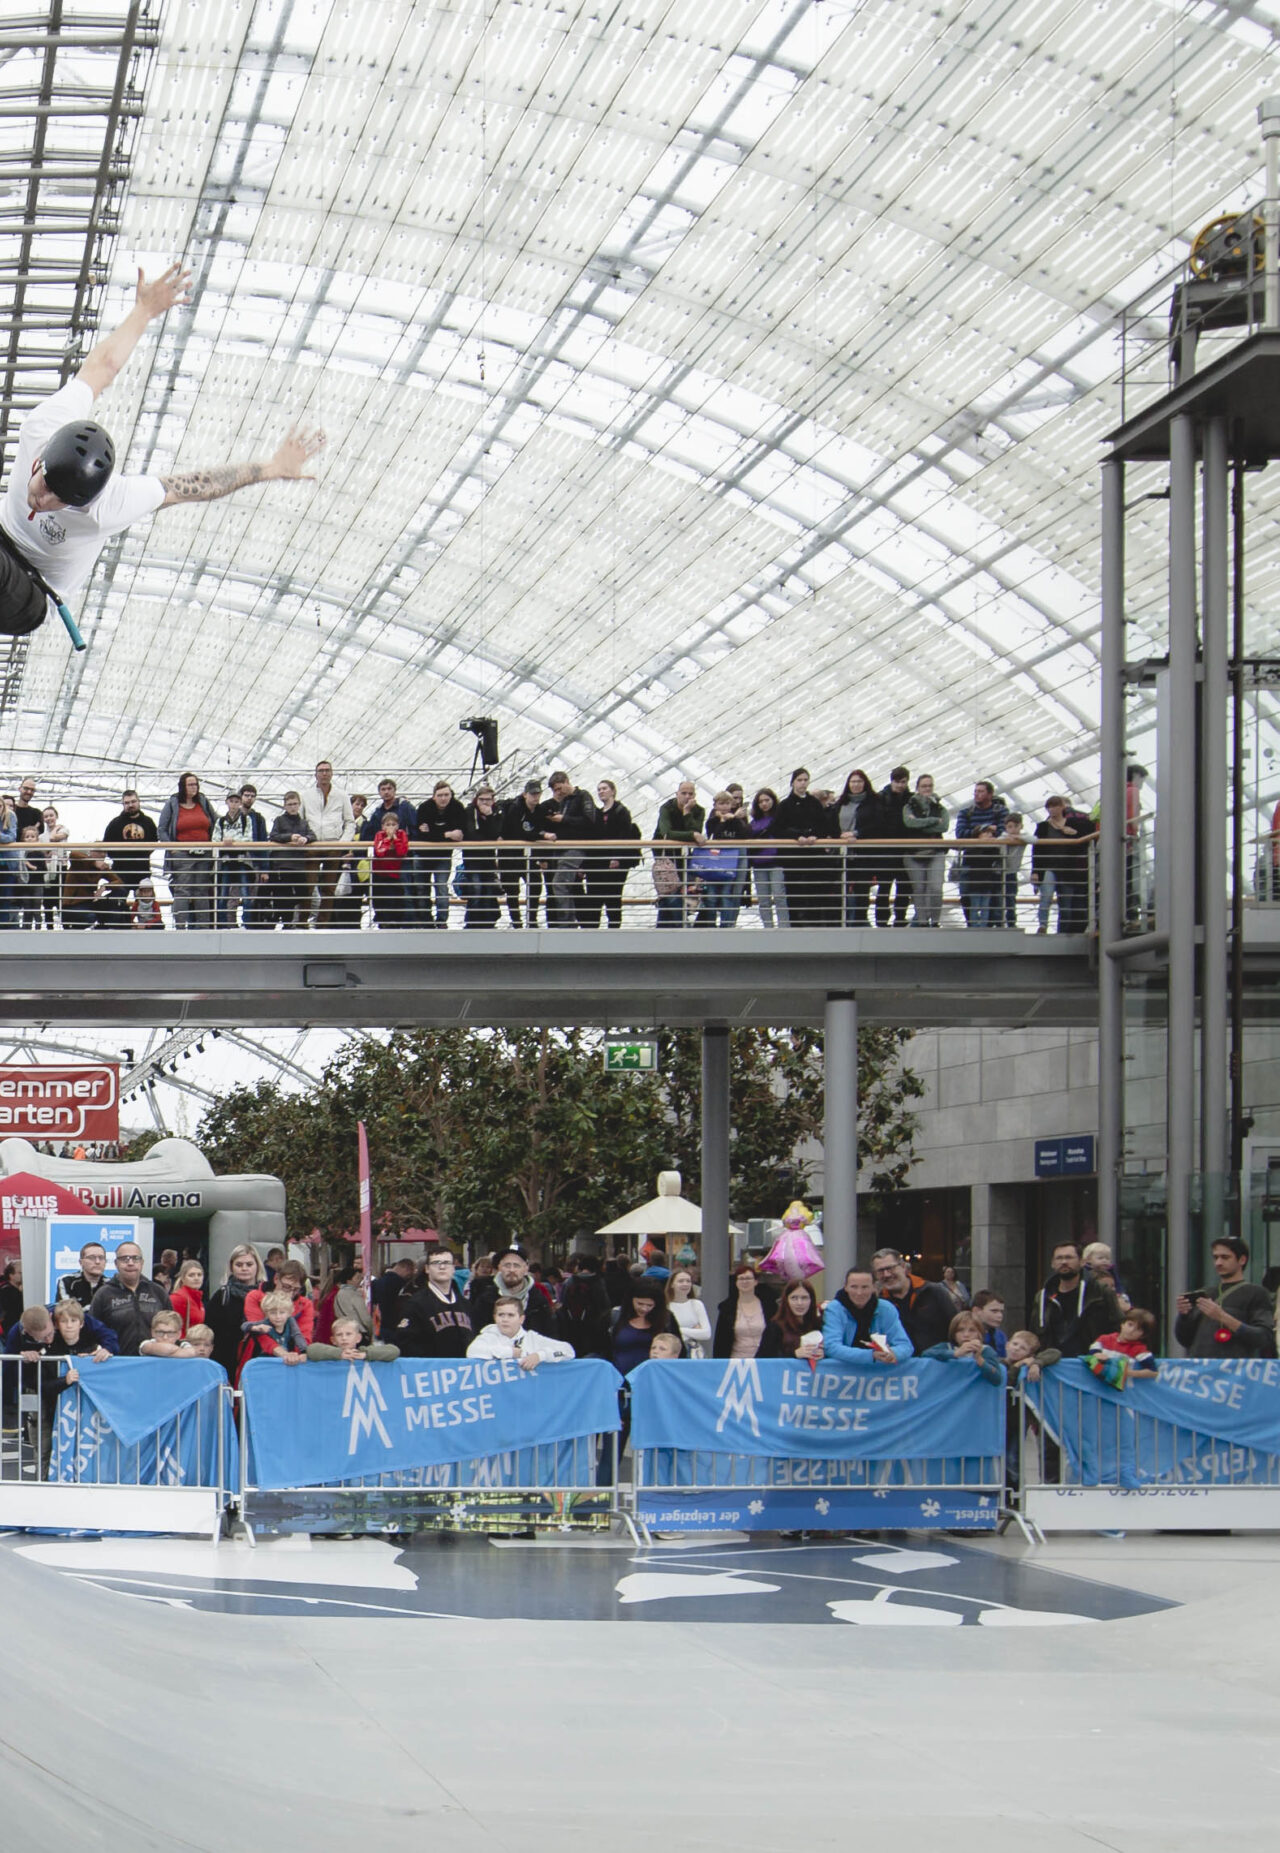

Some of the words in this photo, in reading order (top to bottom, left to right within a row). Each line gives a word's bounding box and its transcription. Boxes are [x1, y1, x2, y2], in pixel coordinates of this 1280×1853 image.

[127, 1187, 201, 1208] Arena
[782, 1370, 919, 1401] LEIPZIGER
[1155, 1361, 1245, 1409] MESSE
[405, 1394, 495, 1431] MESSE
[778, 1403, 870, 1431] MESSE
[660, 1509, 716, 1524] Leipziger
[719, 1511, 740, 1523] der
